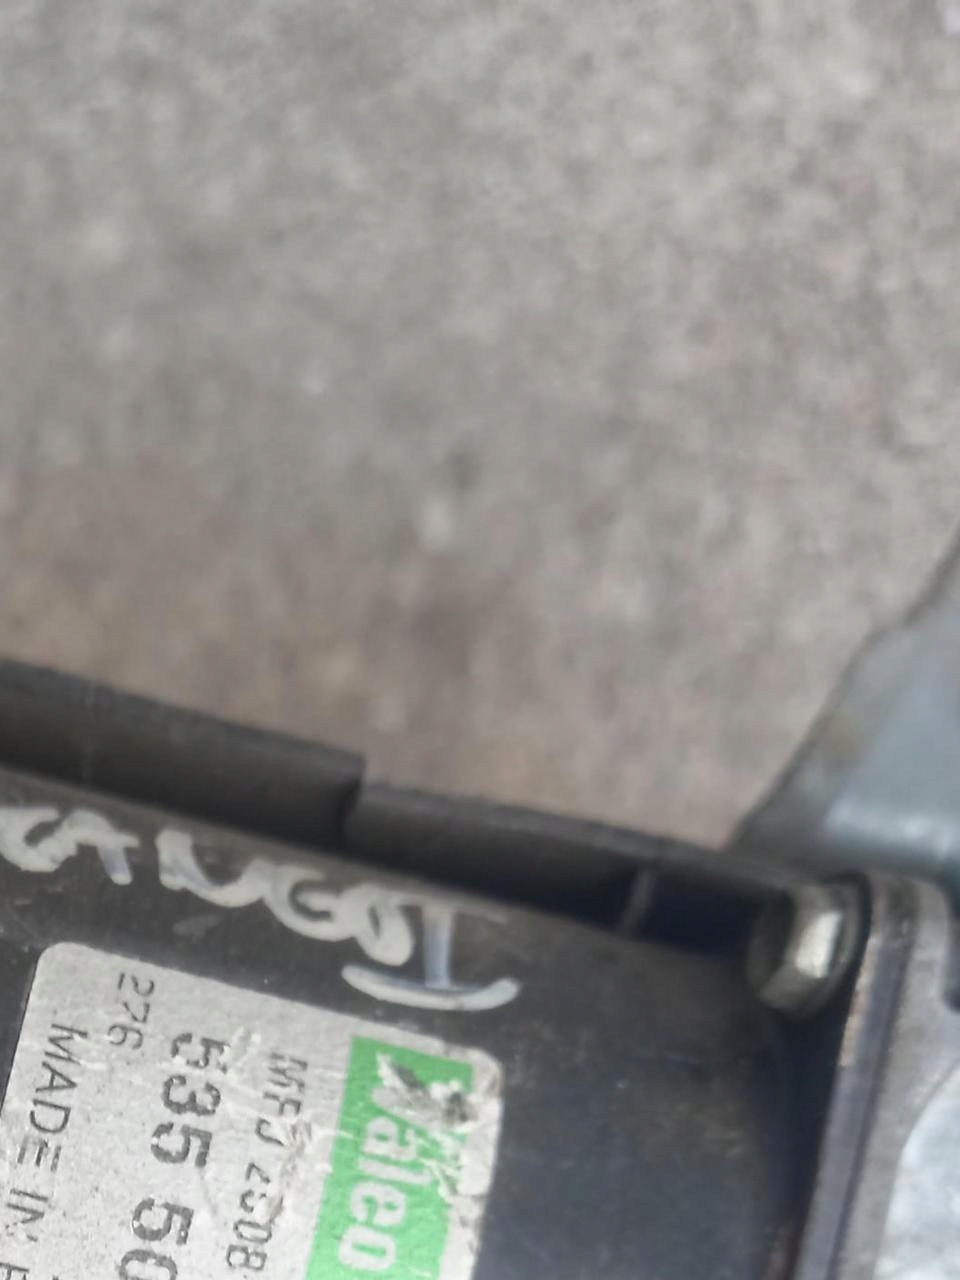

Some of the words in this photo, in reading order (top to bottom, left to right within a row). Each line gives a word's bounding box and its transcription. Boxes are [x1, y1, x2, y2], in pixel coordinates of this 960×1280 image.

[107, 971, 156, 1050] 276
[16, 1022, 88, 1173] MADE
[150, 1032, 232, 1168] 535
[337, 1052, 460, 1273] Valeo
[4, 1187, 50, 1243] IN
